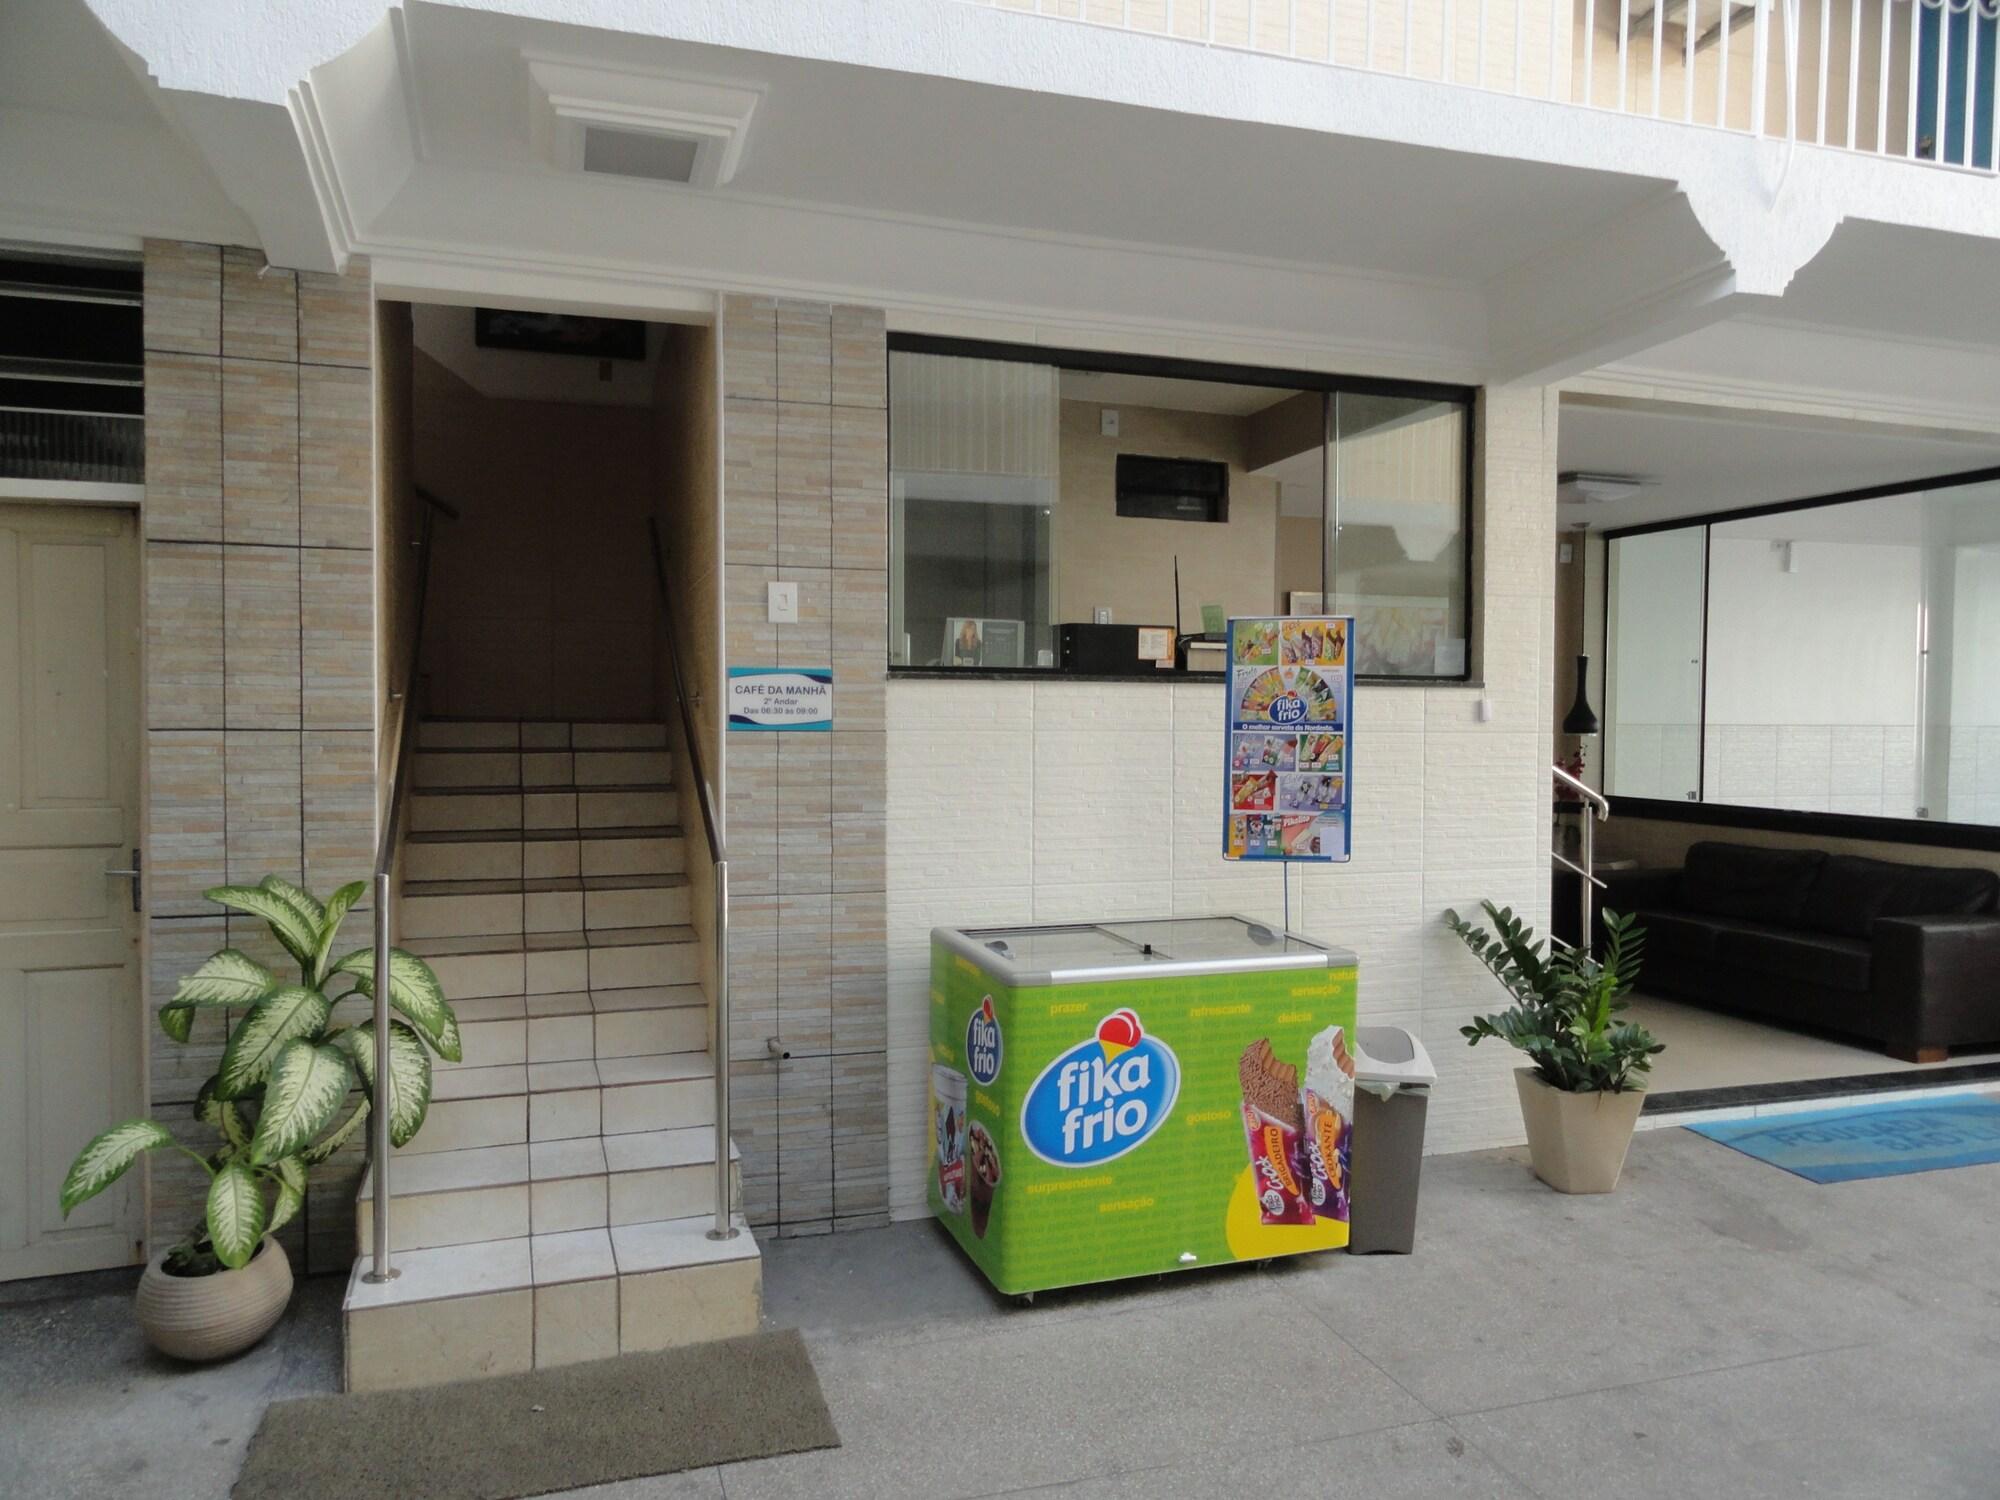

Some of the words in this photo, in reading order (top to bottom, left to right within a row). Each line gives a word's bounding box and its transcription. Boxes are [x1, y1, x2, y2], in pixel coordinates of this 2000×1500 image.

[735, 684, 764, 695] CAFÉ
[767, 685, 783, 695] DA
[786, 685, 826, 696] MANHÃ
[774, 697, 798, 705] Andar
[1276, 698, 1301, 711] fika
[1278, 709, 1300, 721] frio
[1291, 985, 1341, 997] sensação
[1050, 1003, 1088, 1016] prazer
[1190, 1004, 1251, 1018] refrescante
[973, 1017, 996, 1049] fika
[974, 1046, 994, 1076] frio
[1056, 1054, 1151, 1112] fika
[1061, 1094, 1148, 1155] frio
[1187, 1110, 1232, 1126] gostoso
[1269, 1128, 1291, 1187] BRIGADEIRO
[1323, 1122, 1337, 1178] CROKANTE
[1026, 1175, 1113, 1195] surpreendente
[1099, 1197, 1155, 1213] sensação
